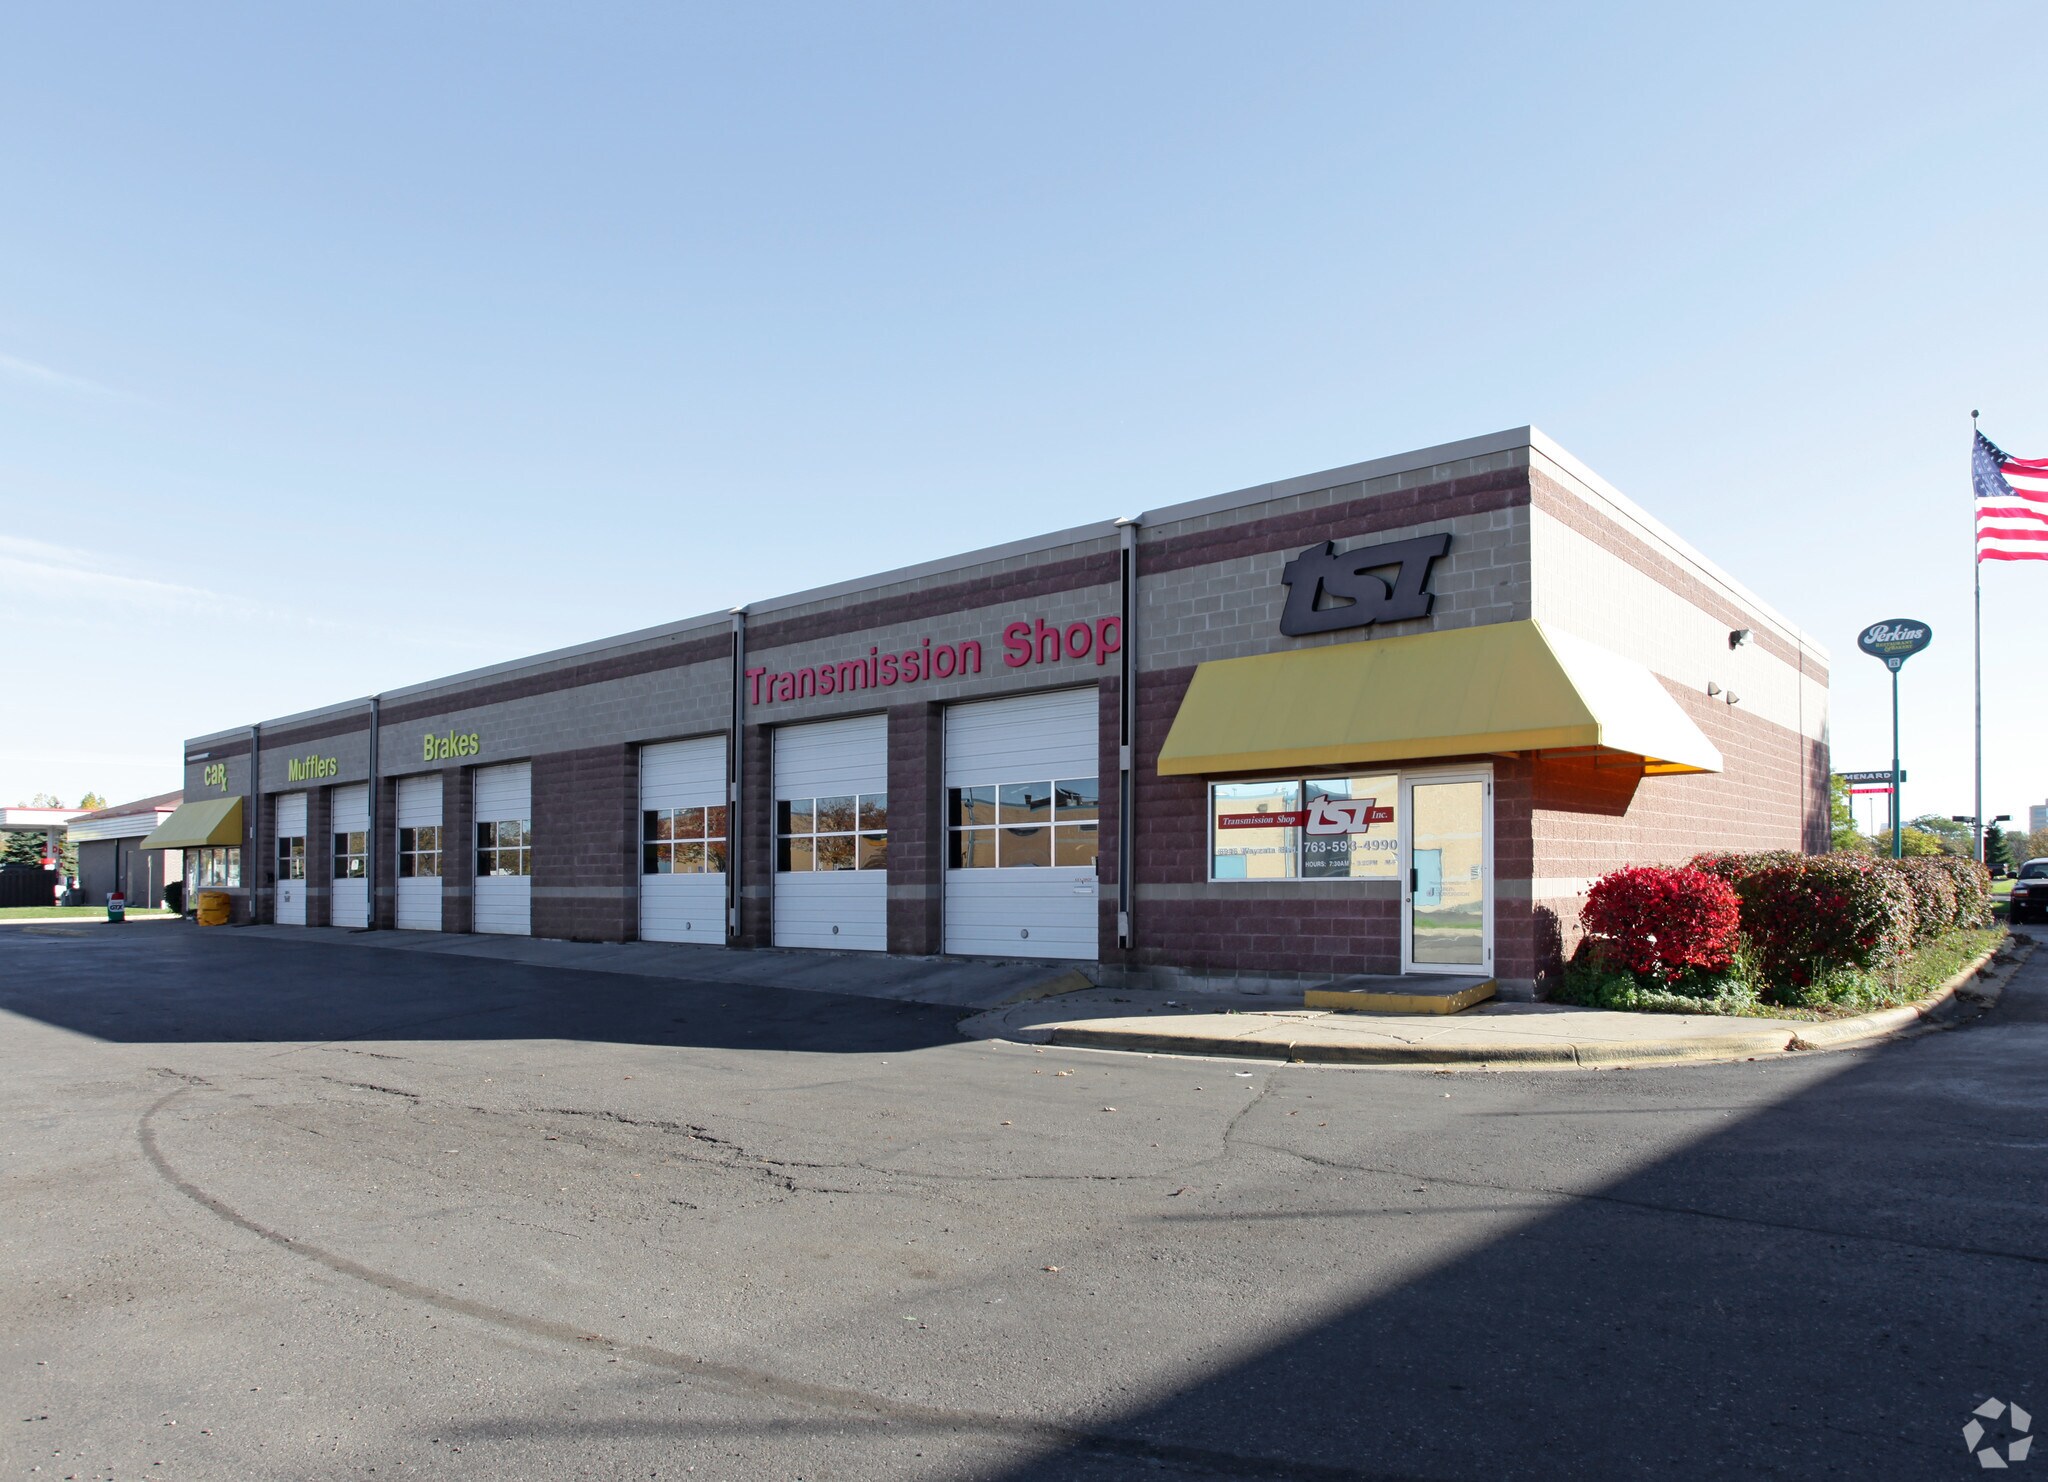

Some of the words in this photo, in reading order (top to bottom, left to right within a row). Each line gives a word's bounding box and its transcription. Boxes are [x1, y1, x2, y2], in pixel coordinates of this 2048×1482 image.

[1863, 624, 1923, 645] Perkins
[745, 638, 982, 705] Transmission
[1003, 616, 1121, 668] Shop
[423, 730, 480, 761] Brakes
[288, 754, 338, 782] Mufflers
[1843, 772, 1893, 780] MENARD
[1222, 815, 1274, 825] Transmission
[1277, 814, 1296, 825] Shop
[1371, 810, 1388, 820] Inc.
[1303, 839, 1398, 853] 763-593-4990
